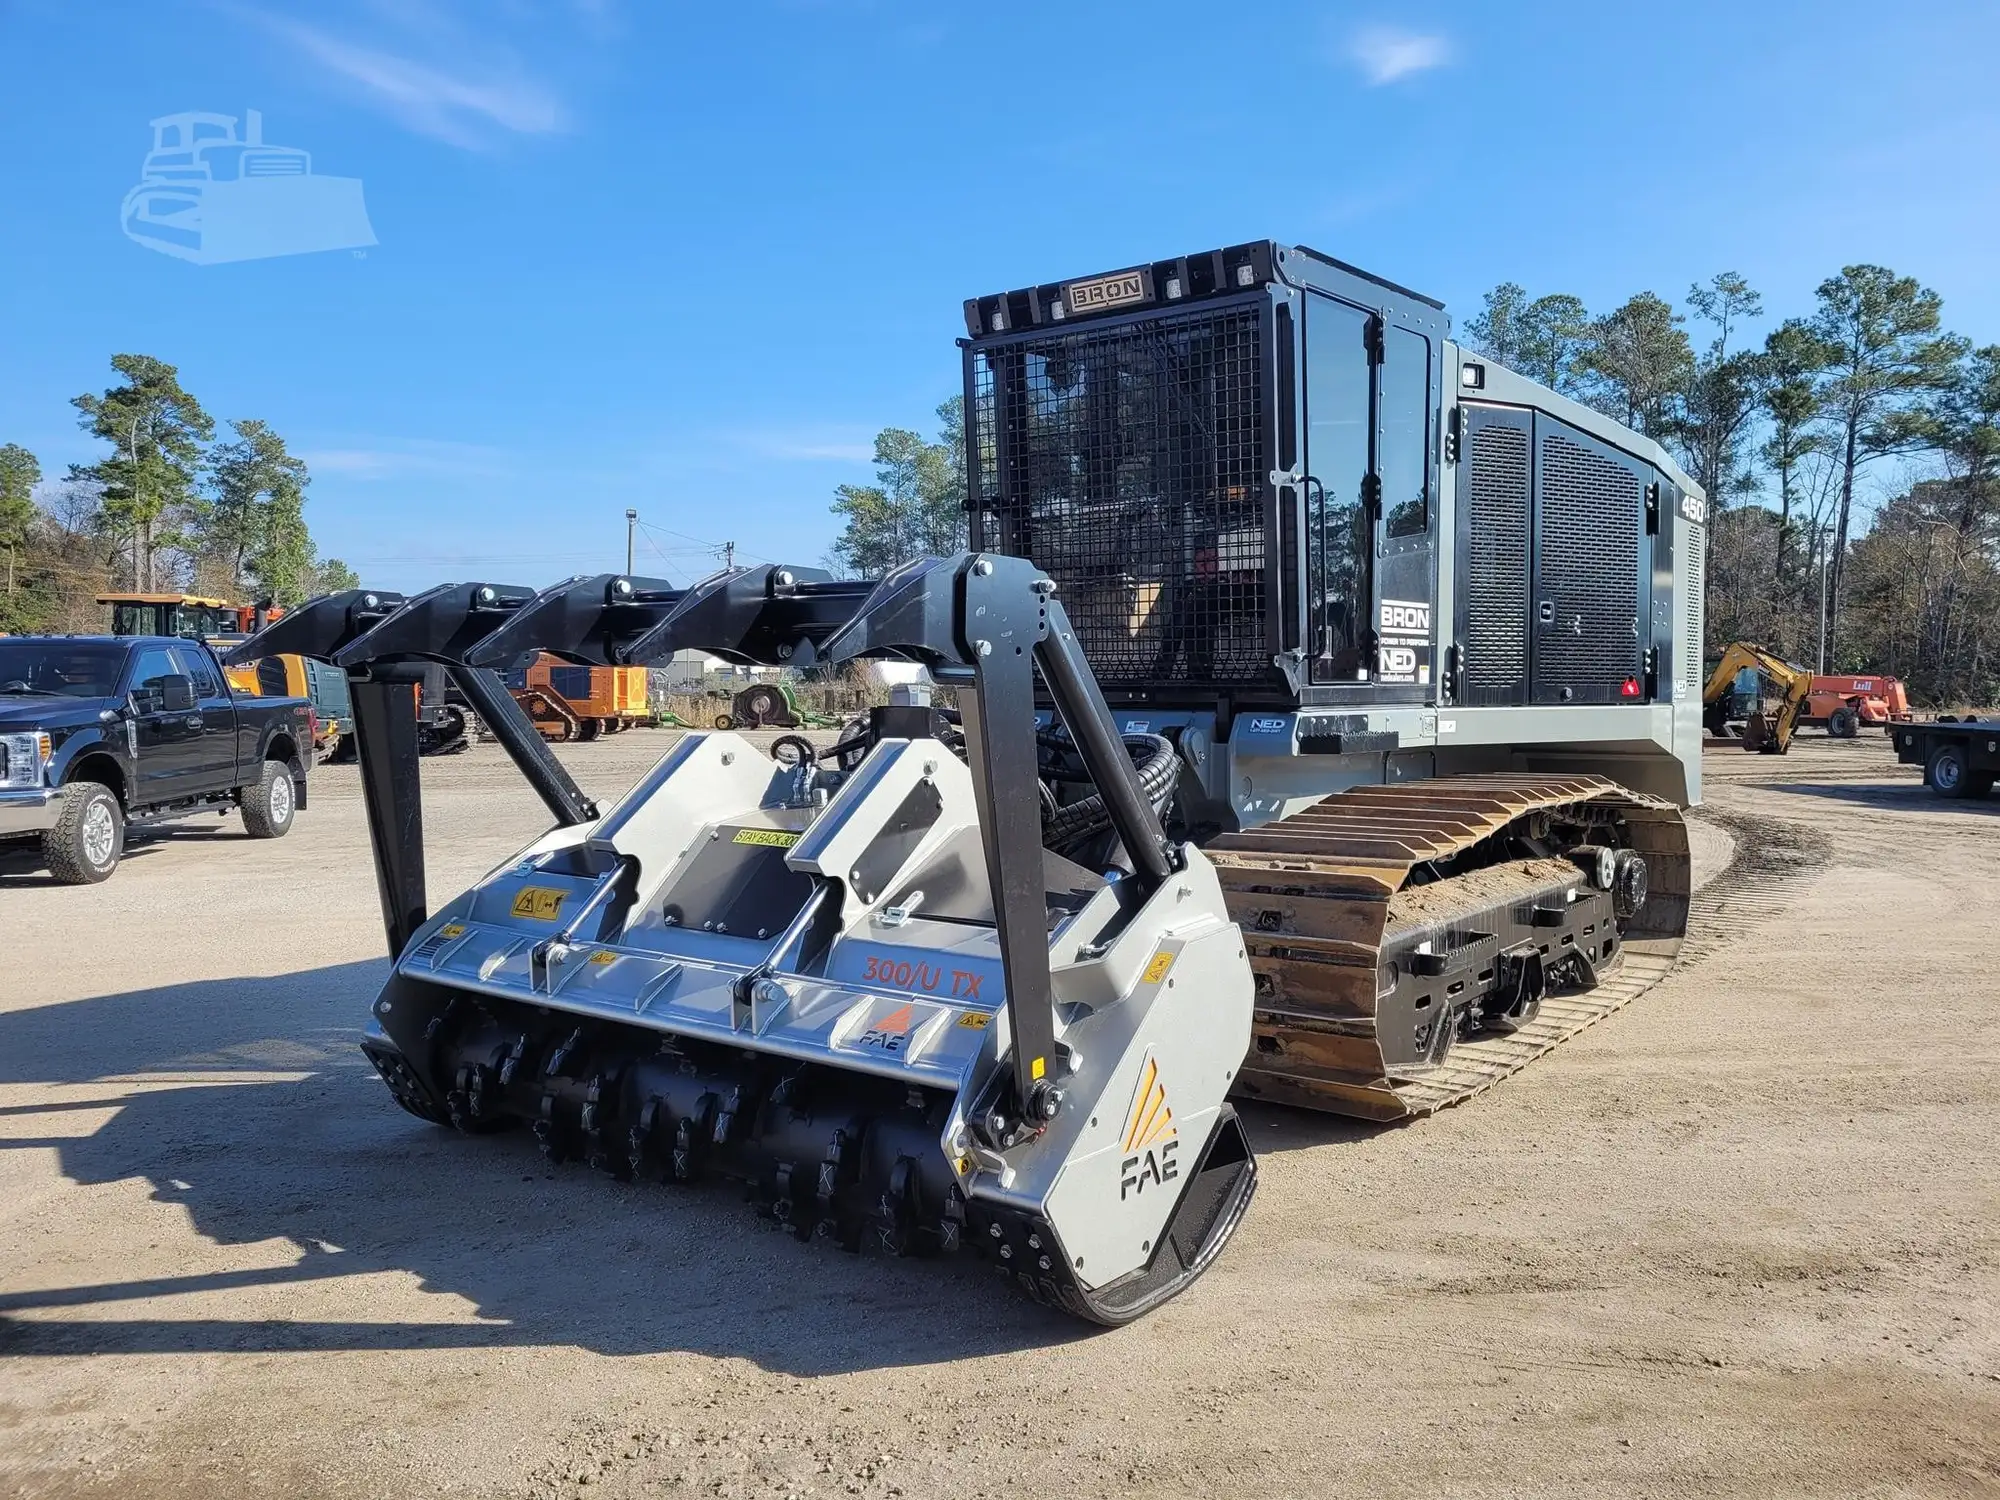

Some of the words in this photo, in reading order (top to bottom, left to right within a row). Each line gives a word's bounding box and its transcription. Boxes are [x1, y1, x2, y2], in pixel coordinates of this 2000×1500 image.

[1073, 279, 1141, 305] BRON
[1682, 495, 1704, 523] 450
[1381, 606, 1430, 629] BRON
[1381, 648, 1415, 672] NED
[1853, 680, 1872, 691] Lull
[1251, 719, 1286, 729] NED
[736, 831, 757, 842] STAY
[757, 833, 782, 845] BACK
[862, 956, 942, 992] 300/U
[952, 970, 985, 999] TX
[859, 1030, 905, 1051] FAE
[1121, 1140, 1179, 1201] FAE
